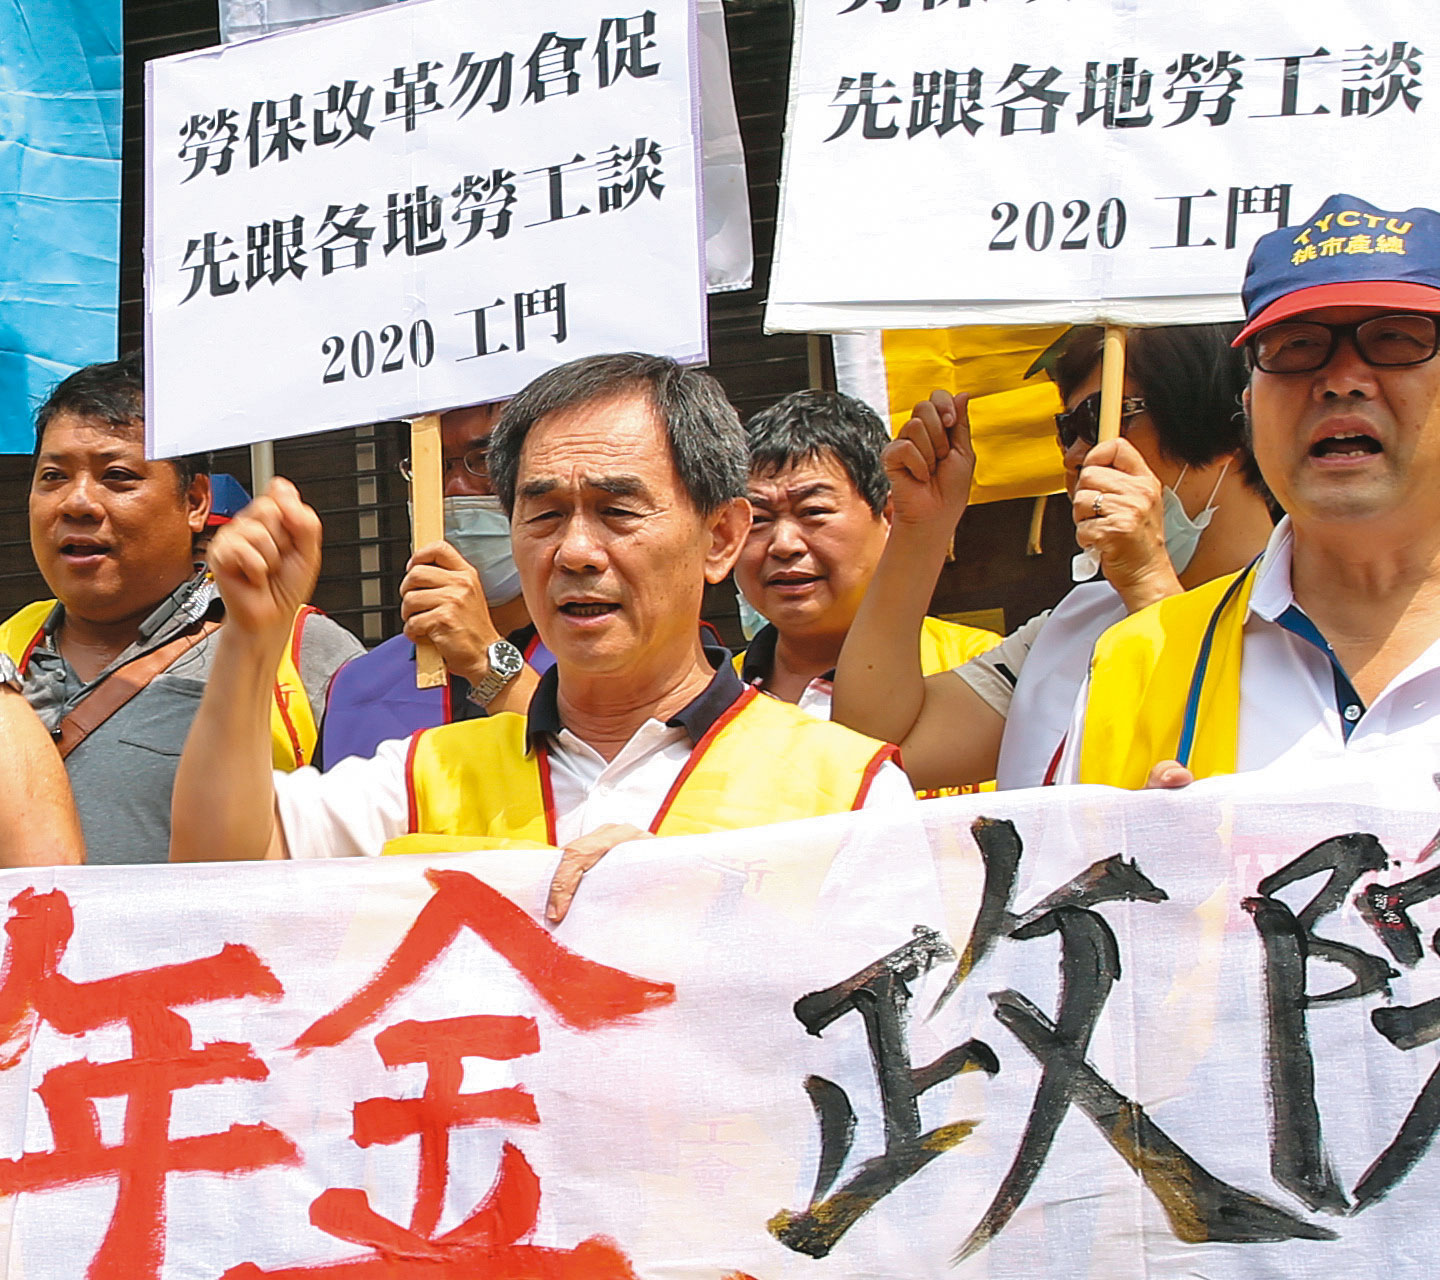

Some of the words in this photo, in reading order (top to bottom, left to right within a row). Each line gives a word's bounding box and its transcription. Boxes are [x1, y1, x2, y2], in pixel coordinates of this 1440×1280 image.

[178, 9, 662, 187] 勞保改革勿倉促
[823, 40, 1425, 144] 先跟各地勞工談
[179, 136, 666, 308] 先跟各地勞工談
[989, 196, 1127, 253] 2020
[1292, 210, 1413, 246] TYCTU
[320, 316, 435, 385] 2020
